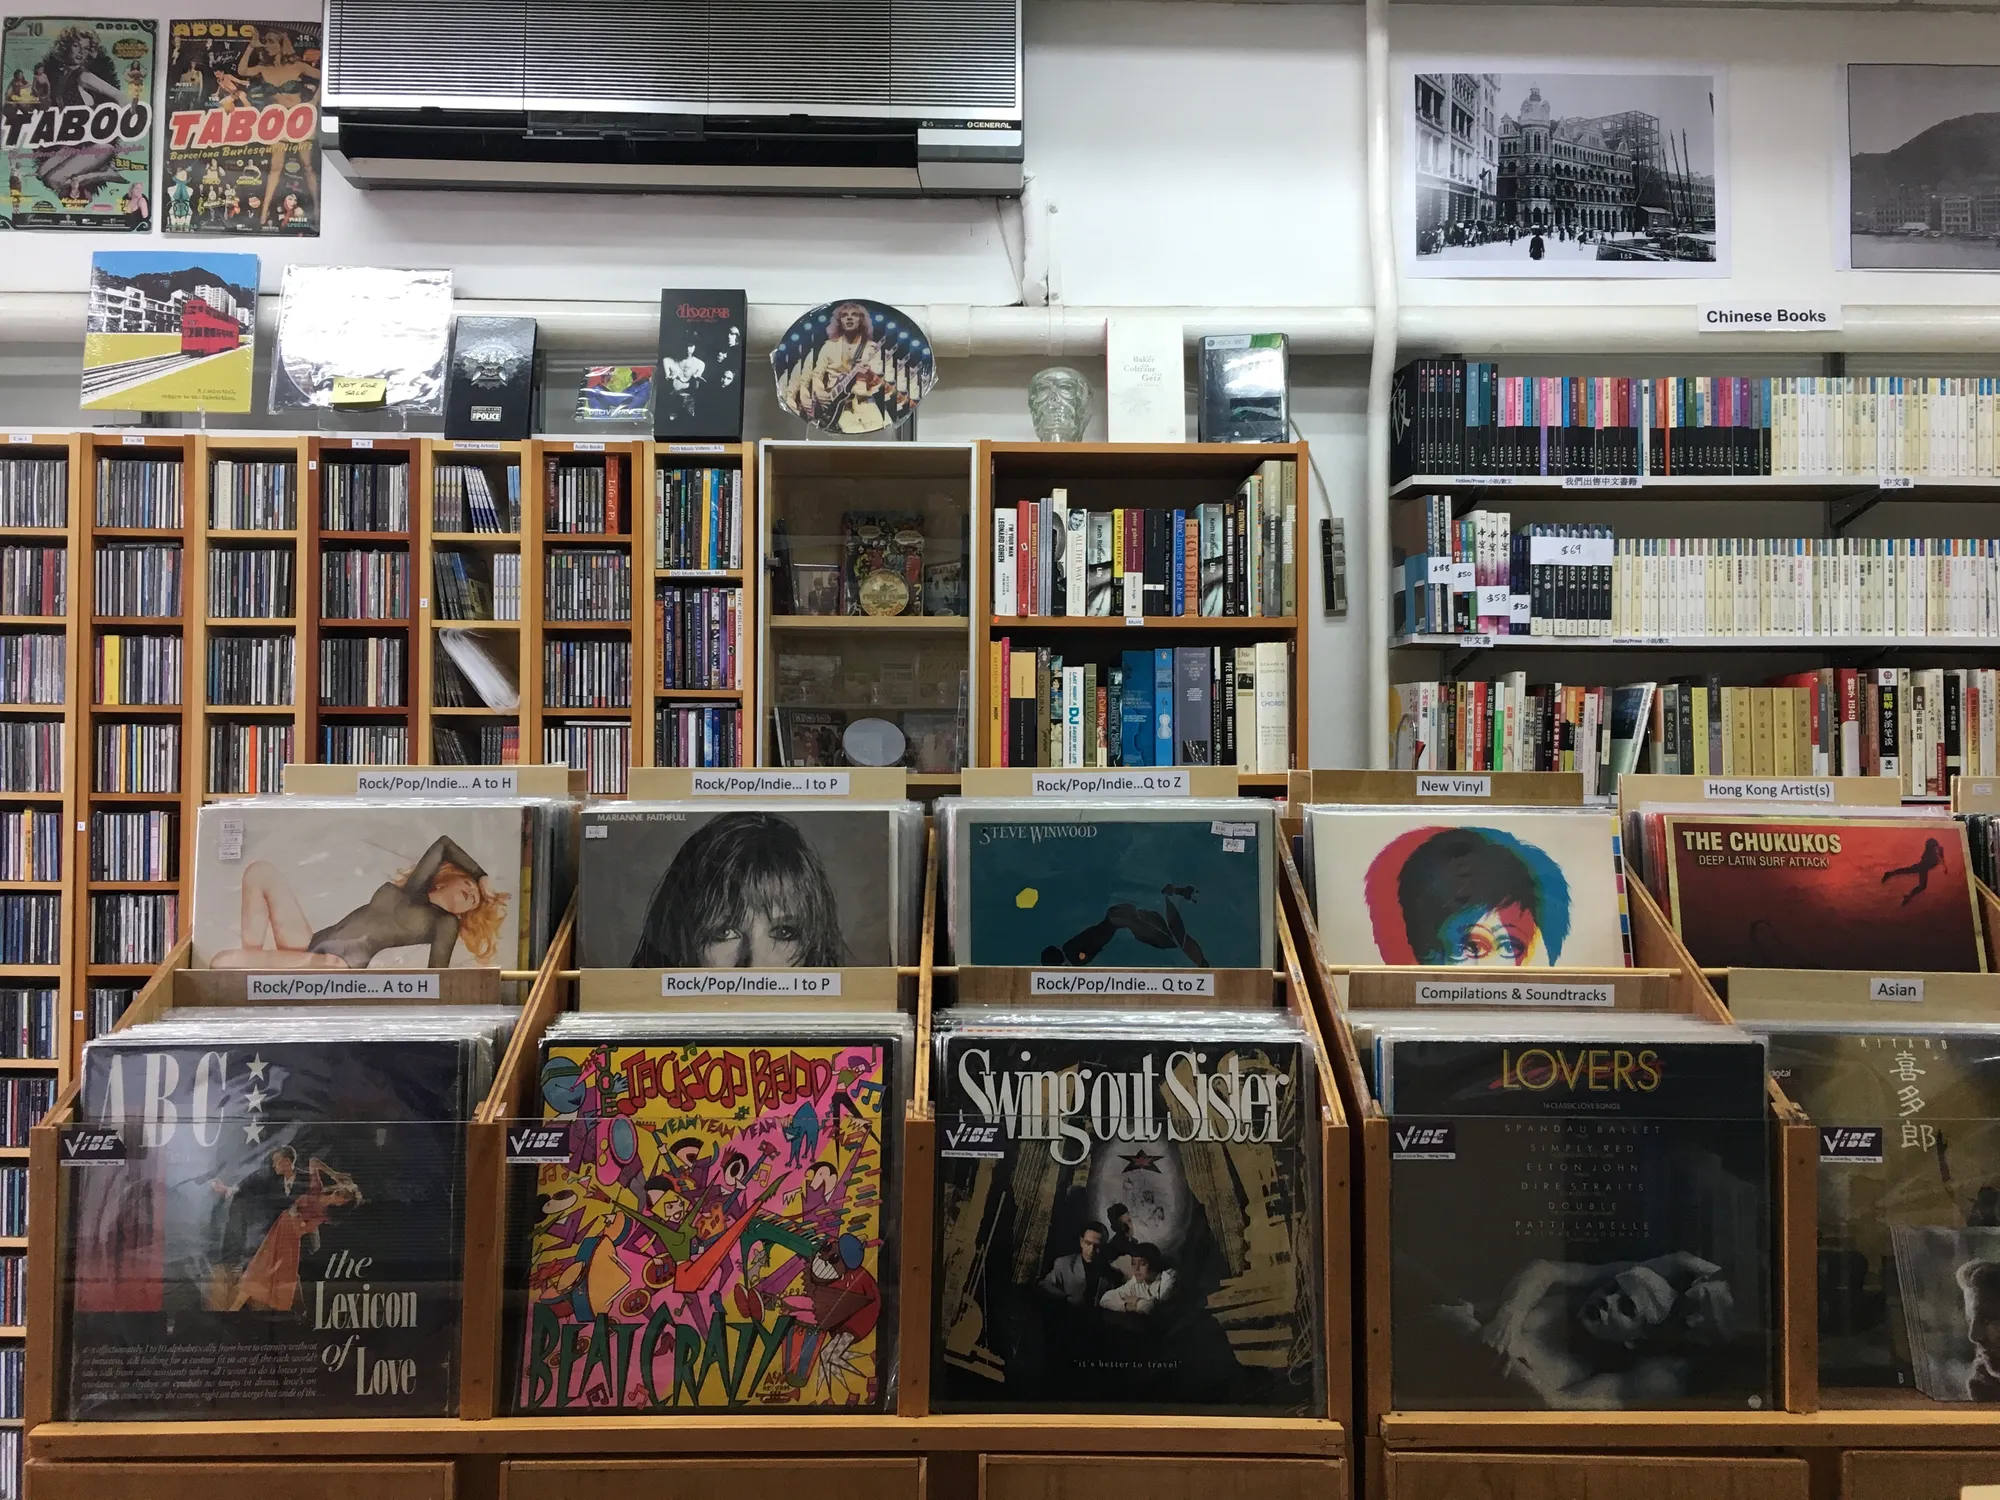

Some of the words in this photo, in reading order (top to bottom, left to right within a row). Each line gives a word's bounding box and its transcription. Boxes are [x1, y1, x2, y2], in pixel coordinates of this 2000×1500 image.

[27, 22, 44, 37] 10
[95, 22, 140, 31] APOLO
[173, 24, 255, 37] APOLO
[4, 104, 148, 147] TABOO
[172, 107, 314, 148] TABOO
[170, 151, 219, 160] Barcelona
[222, 145, 279, 157] Burlesque
[281, 143, 313, 154] Nights
[1706, 309, 1773, 323] Chinese
[1777, 309, 1827, 323] Books
[1133, 355, 1155, 363] Baker
[1123, 365, 1156, 373] Coltrane
[1141, 373, 1162, 382] Getz
[476, 412, 500, 420] POLICE
[587, 407, 644, 416] DELIVERANCE
[1565, 477, 1637, 486] 我們出售中文書籍
[1884, 478, 1910, 486] 中文書
[608, 512, 616, 520] Pi
[1186, 534, 1196, 558] BEAT
[1561, 544, 1581, 556] $69
[1433, 563, 1450, 572] $88
[1486, 593, 1507, 603] $58
[1463, 637, 1491, 645] 中文書
[1883, 693, 1894, 710] 图解
[1069, 707, 1079, 725] DJ
[1681, 694, 1690, 725] 欧洲史
[1666, 712, 1675, 750] 黄金草原
[358, 777, 469, 792] Rock/Pop/Indie...
[472, 778, 481, 790] A
[484, 778, 498, 790] to
[501, 778, 512, 790] H
[694, 778, 802, 792] Rock/Pop/Indie...
[813, 778, 827, 790] to
[830, 778, 838, 790] P
[1157, 776, 1172, 789] to
[1174, 776, 1182, 789] Z
[1421, 780, 1450, 794] New
[1453, 780, 1484, 794] Vinyl
[1708, 784, 1742, 798] Hong
[1746, 784, 1778, 798] Kong
[1780, 784, 1830, 798] Artist(s)
[597, 813, 643, 822] MARIANNE
[646, 813, 686, 822] FAITHFULL
[979, 825, 1026, 845] STEVE
[1030, 824, 1098, 844] WINWOOD
[1682, 831, 1722, 854] THE
[1730, 831, 1842, 854] CHUKUKOS
[1698, 854, 1725, 868] DEEP
[1728, 854, 1756, 868] LATIN
[1760, 854, 1786, 868] SURF
[1788, 854, 1830, 868] ATTACK!
[252, 978, 380, 996] Rock/Pop/Indie...
[383, 980, 394, 993] A
[398, 980, 413, 993] to
[416, 980, 428, 993] H
[666, 977, 790, 992] Rock/Pop/Indie...
[793, 978, 798, 990] I
[802, 978, 818, 990] to
[822, 978, 830, 990] P
[1036, 976, 1158, 993] Rock/Pop/Indie...
[1162, 978, 1174, 993] Q
[1178, 978, 1194, 991] to
[1196, 978, 1205, 991] Z
[1877, 982, 1917, 996] Asian
[1421, 986, 1508, 1003] Compilations
[1511, 988, 1522, 1000] &
[1525, 988, 1607, 1002] Soundtracks
[1860, 1038, 1948, 1050] KITARO
[1502, 1048, 1662, 1092] LOVERS
[596, 1044, 618, 1118] JOE
[616, 1048, 749, 1112] JACKSON
[748, 1048, 833, 1118] BAND
[98, 1050, 228, 1148] ABC
[1542, 1102, 1550, 1110] 16
[1550, 1102, 1577, 1110] CLASSIC
[1577, 1102, 1596, 1110] LOVE
[1596, 1102, 1621, 1110] SONGS
[1889, 1050, 1937, 1152] 喜多郎
[958, 1048, 1093, 1166] Swing
[1090, 1053, 1163, 1143] out
[1166, 1050, 1289, 1144] Sister
[655, 1117, 698, 1138] YEAH
[699, 1118, 736, 1140] YEAH
[738, 1117, 778, 1142] YEAH
[945, 1123, 999, 1148] VIBE
[1504, 1124, 1587, 1134] SPANDAU
[1597, 1124, 1660, 1134] BALLET
[64, 1131, 118, 1158] VIBE
[509, 1128, 564, 1154] VIBE
[1395, 1126, 1448, 1151] VIBE
[1823, 1129, 1876, 1153] VIBE
[1530, 1144, 1593, 1152] SIMPLY
[1604, 1144, 1634, 1152] RED
[1526, 1163, 1582, 1172] ELTON
[1592, 1163, 1639, 1172] JOHN
[1520, 1182, 1560, 1191] DIRE
[1570, 1182, 1644, 1191] STRAITS
[1548, 1202, 1617, 1211] DOUBLE
[1515, 1221, 1565, 1230] PATTI
[1575, 1221, 1649, 1230] LABELLE
[325, 1249, 372, 1280] the
[313, 1280, 418, 1330] Lexicon
[322, 1334, 360, 1372] of
[522, 1302, 646, 1408] BEAT
[641, 1302, 797, 1408] CRAZY
[356, 1346, 417, 1396] Love
[1074, 1358, 1095, 1368] "it's
[1098, 1359, 1130, 1368] better
[1133, 1360, 1144, 1368] to
[1148, 1358, 1182, 1369] travel"
